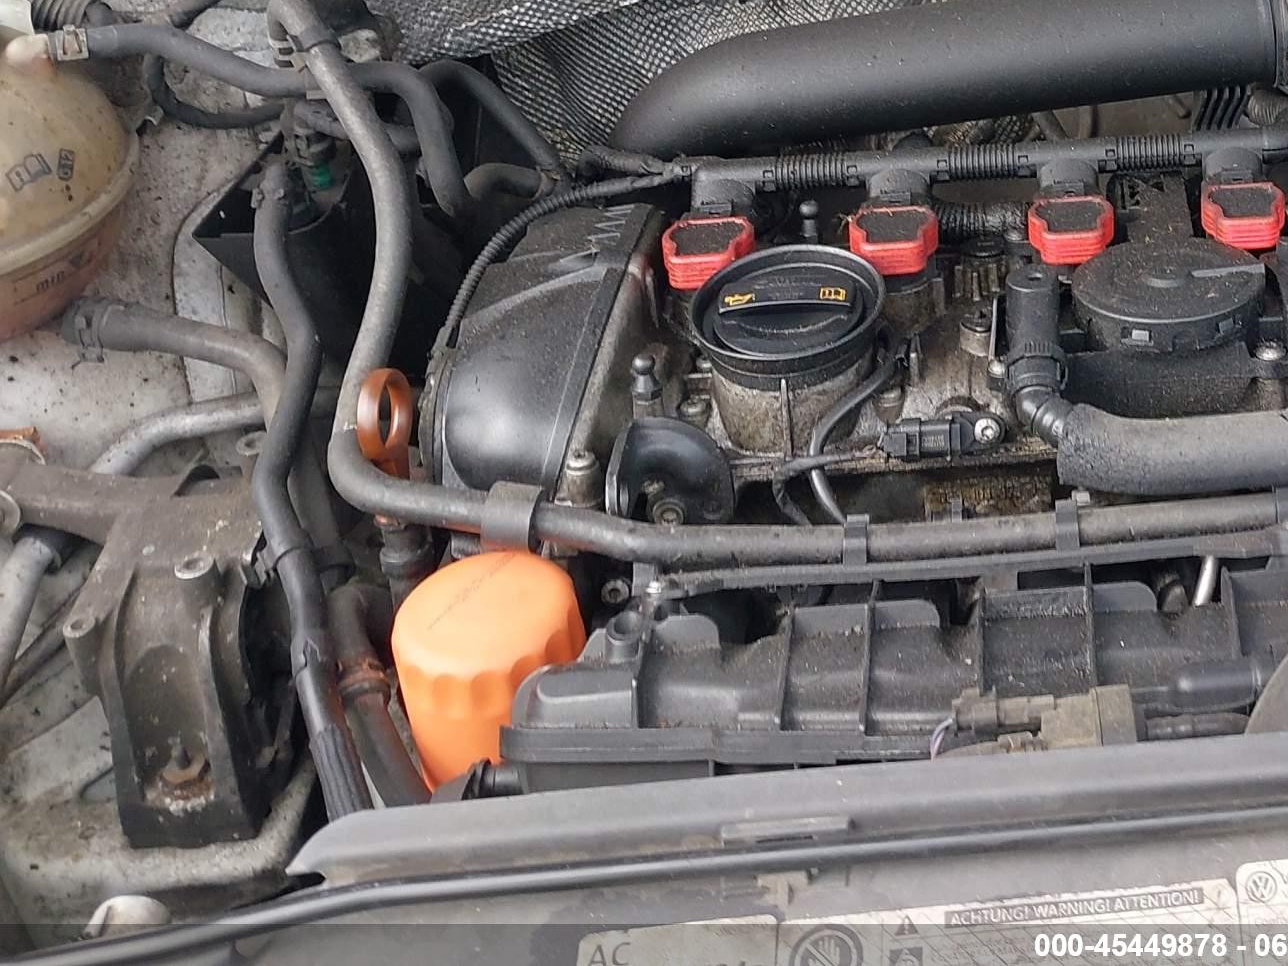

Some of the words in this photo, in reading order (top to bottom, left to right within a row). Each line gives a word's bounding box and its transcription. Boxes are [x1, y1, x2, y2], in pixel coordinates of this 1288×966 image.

[36, 271, 65, 293] min
[949, 908, 1029, 927] ACHTUNG!
[1032, 900, 1111, 919] WARNING!
[1114, 890, 1199, 912] ATTENTION!
[588, 942, 631, 966] AC
